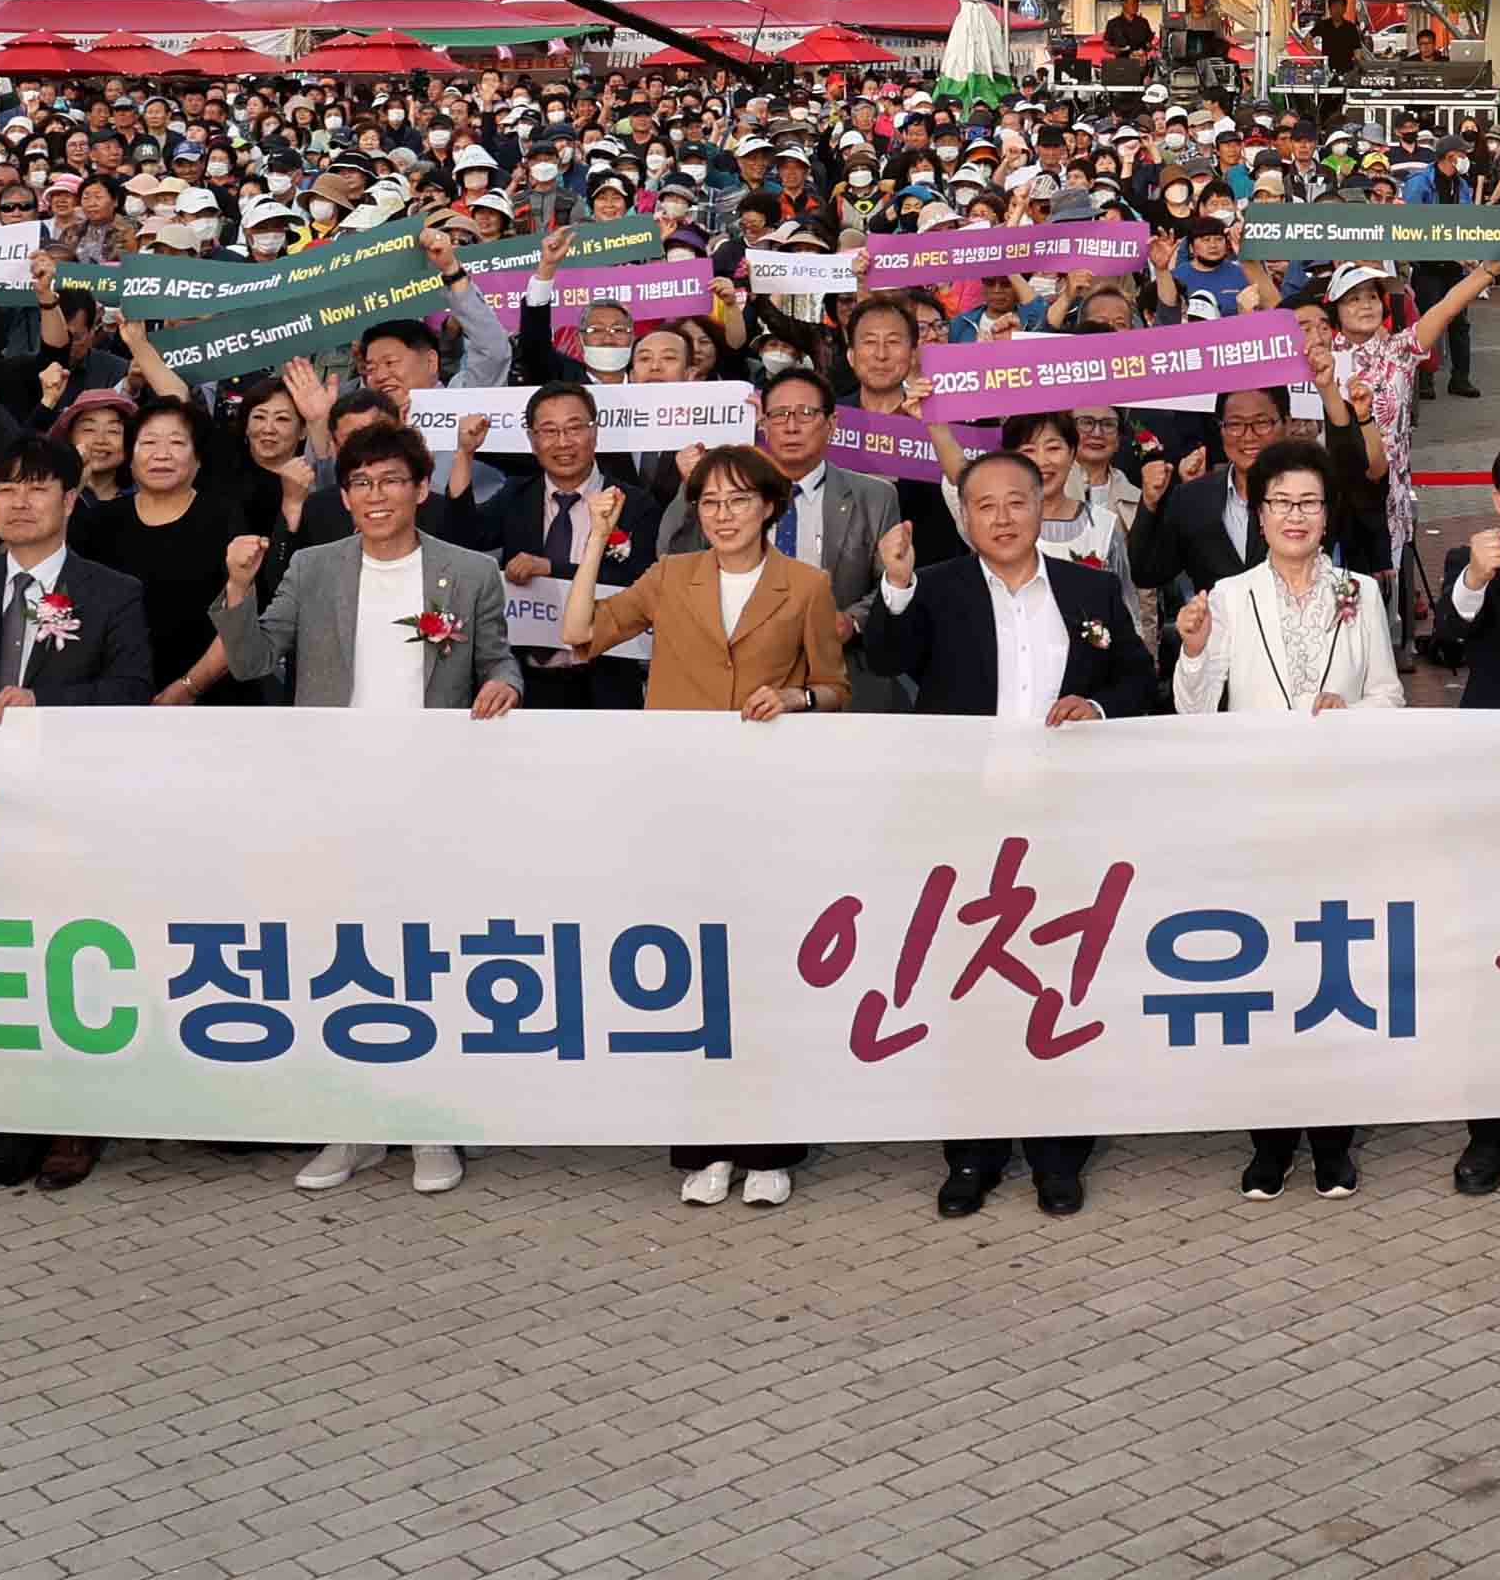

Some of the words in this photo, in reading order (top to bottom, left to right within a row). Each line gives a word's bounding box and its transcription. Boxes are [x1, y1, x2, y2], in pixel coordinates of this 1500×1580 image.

[603, 228, 652, 249] Incheon
[1243, 224, 1282, 242] 2025
[1284, 224, 1324, 242] APEC
[1326, 223, 1386, 242] Summit
[1431, 223, 1453, 242] it's
[122, 276, 162, 297] 2025
[164, 279, 215, 299] APEC
[215, 273, 283, 298] Summit
[328, 252, 351, 273] it's
[353, 234, 416, 264] Incheon
[873, 252, 911, 270] 2025
[911, 250, 949, 268] APEC
[949, 242, 1002, 265] 정상회의
[1004, 241, 1032, 262] 인천
[1033, 238, 1071, 260] 유치를
[1074, 234, 1140, 258] 기원합니다.
[752, 263, 789, 281] 2025
[562, 285, 591, 307] 인천
[635, 278, 704, 304] 기원합니다.
[163, 346, 203, 369] 2025
[205, 334, 251, 361] APEC
[250, 314, 313, 348] Summit
[363, 290, 389, 313] it's
[931, 369, 981, 395] 2025
[983, 364, 1034, 390] APEC
[1035, 356, 1108, 388] 정상회의
[1110, 352, 1148, 380] 인천
[1150, 348, 1204, 378] 유치를
[1206, 334, 1299, 370] 기원합니다.
[410, 412, 457, 430] 2025
[654, 404, 746, 428] 인천입니다
[863, 432, 895, 454] 인천
[166, 915, 735, 1064] 정상회의
[796, 833, 1137, 1064] 인천
[1140, 897, 1419, 1047] 유치
